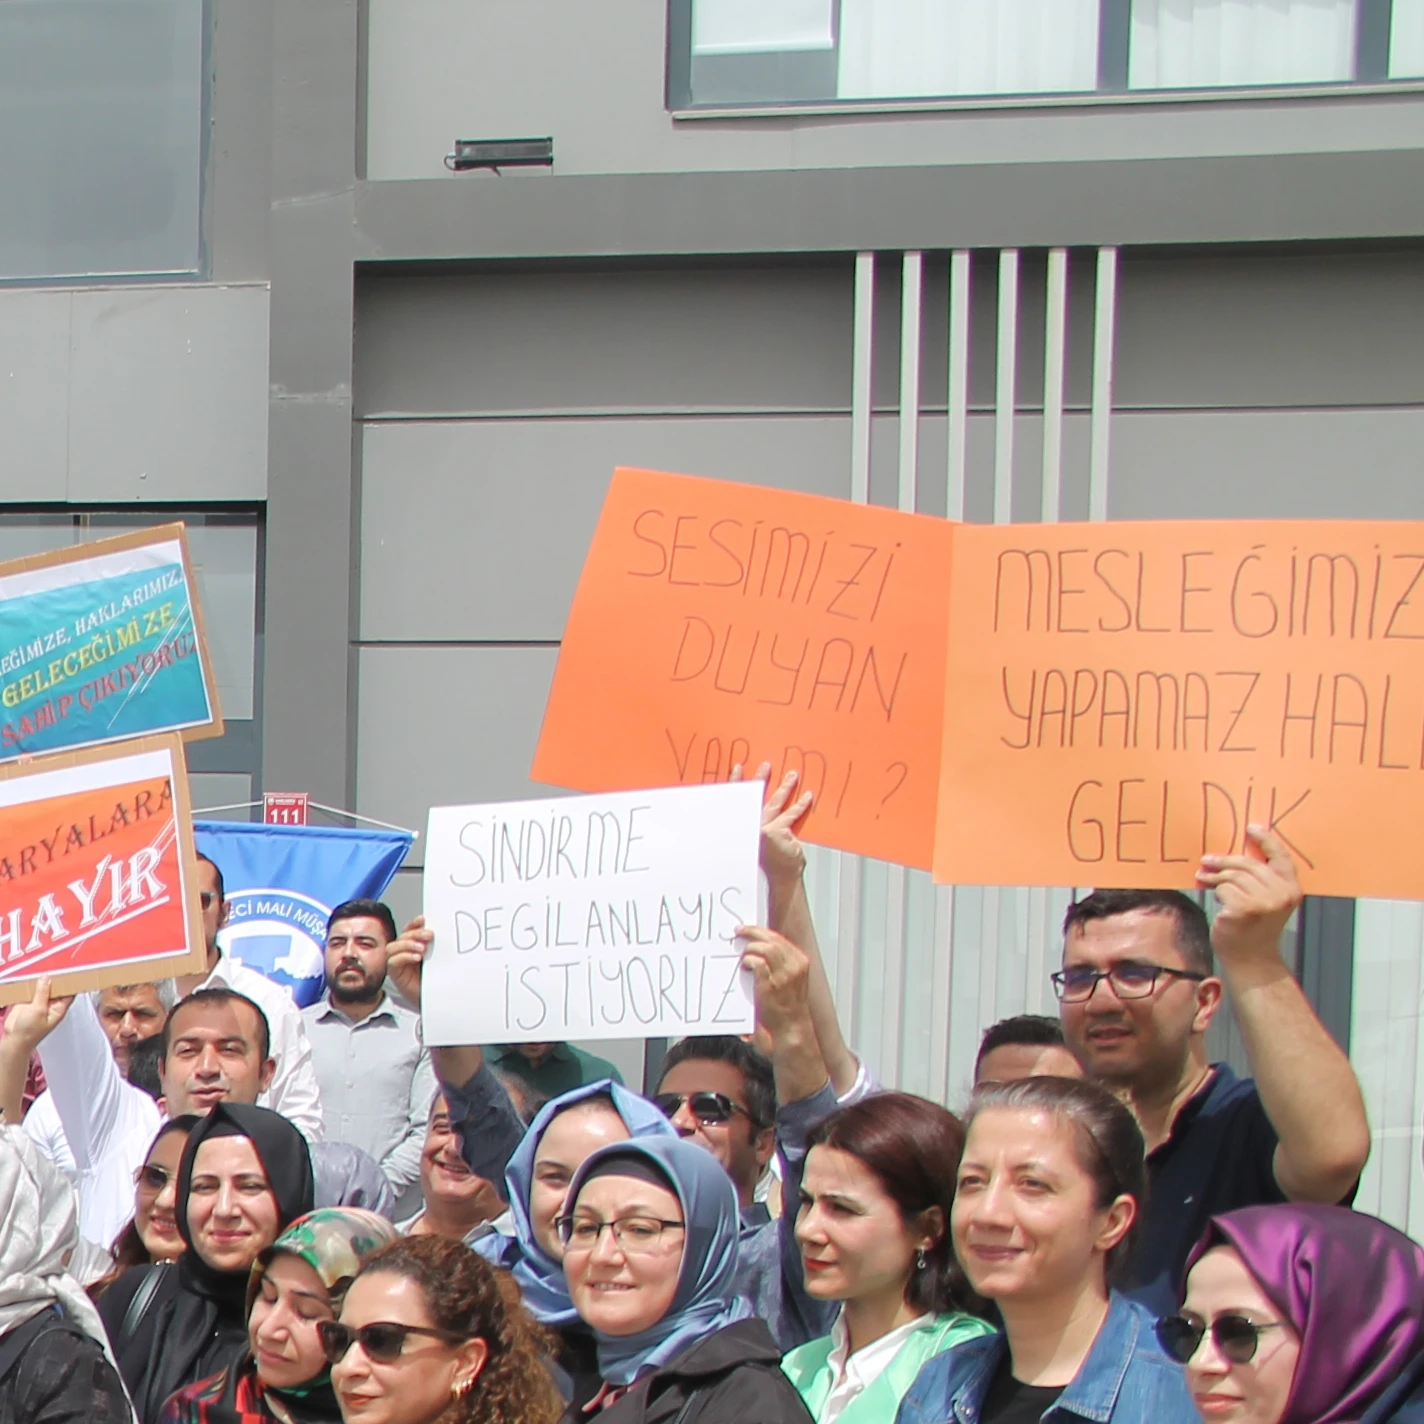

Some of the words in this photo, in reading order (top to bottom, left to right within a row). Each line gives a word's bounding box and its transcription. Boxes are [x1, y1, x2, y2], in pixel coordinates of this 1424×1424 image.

[75, 568, 183, 634] HAKLARIMIZ
[670, 616, 907, 722] DUYAN
[1, 694, 74, 748] SAHİP
[1000, 666, 1261, 752] YAPAMAZ
[1280, 672, 1423, 771] HAL
[292, 908, 328, 941] MÜŞA
